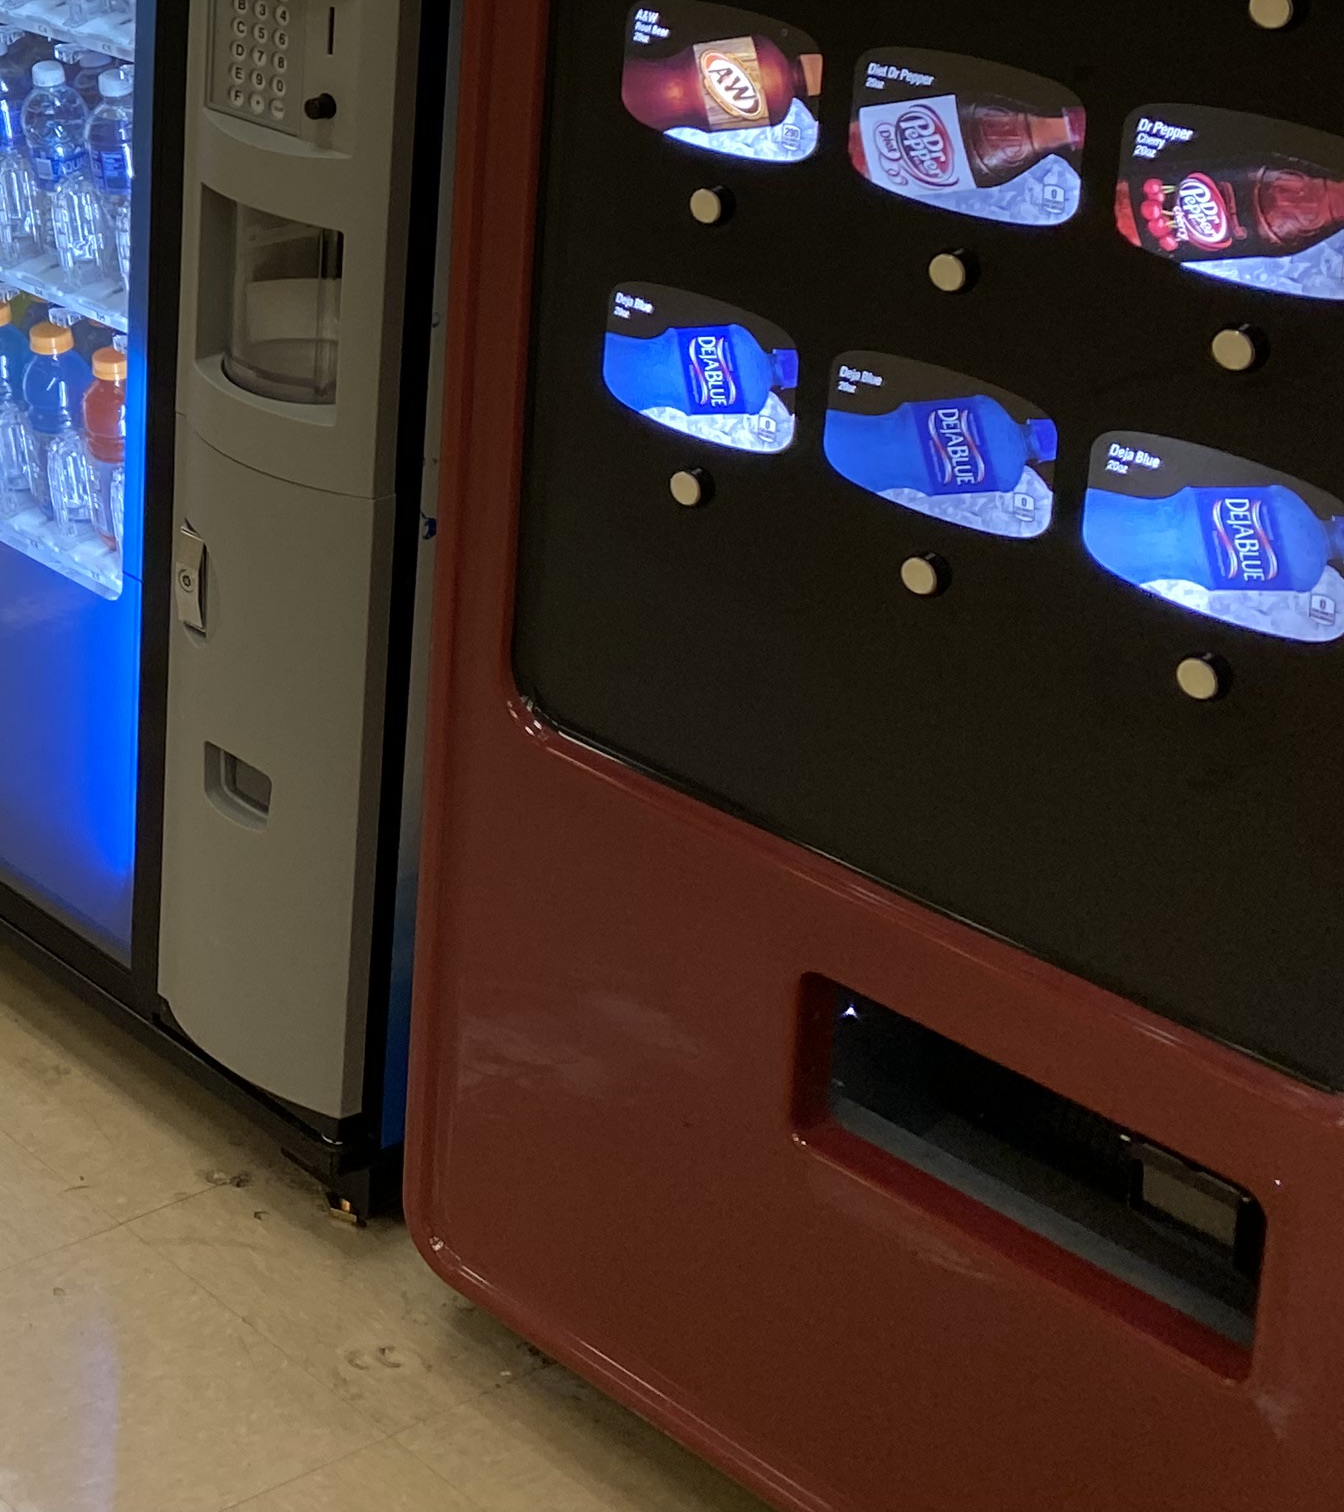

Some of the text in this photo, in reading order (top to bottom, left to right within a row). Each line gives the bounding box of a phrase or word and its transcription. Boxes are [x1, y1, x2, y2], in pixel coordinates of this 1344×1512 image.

[635, 9, 659, 24] A&W
[868, 62, 935, 86] Diet Dr Pepper
[1136, 133, 1165, 149] Cherry
[1137, 118, 1194, 141] Dr Pepper
[899, 114, 943, 180] Pepper
[928, 136, 946, 164] Dr
[1179, 182, 1216, 236] Pepper
[1205, 202, 1220, 226] Dr
[1108, 443, 1161, 469] Deja Blue
